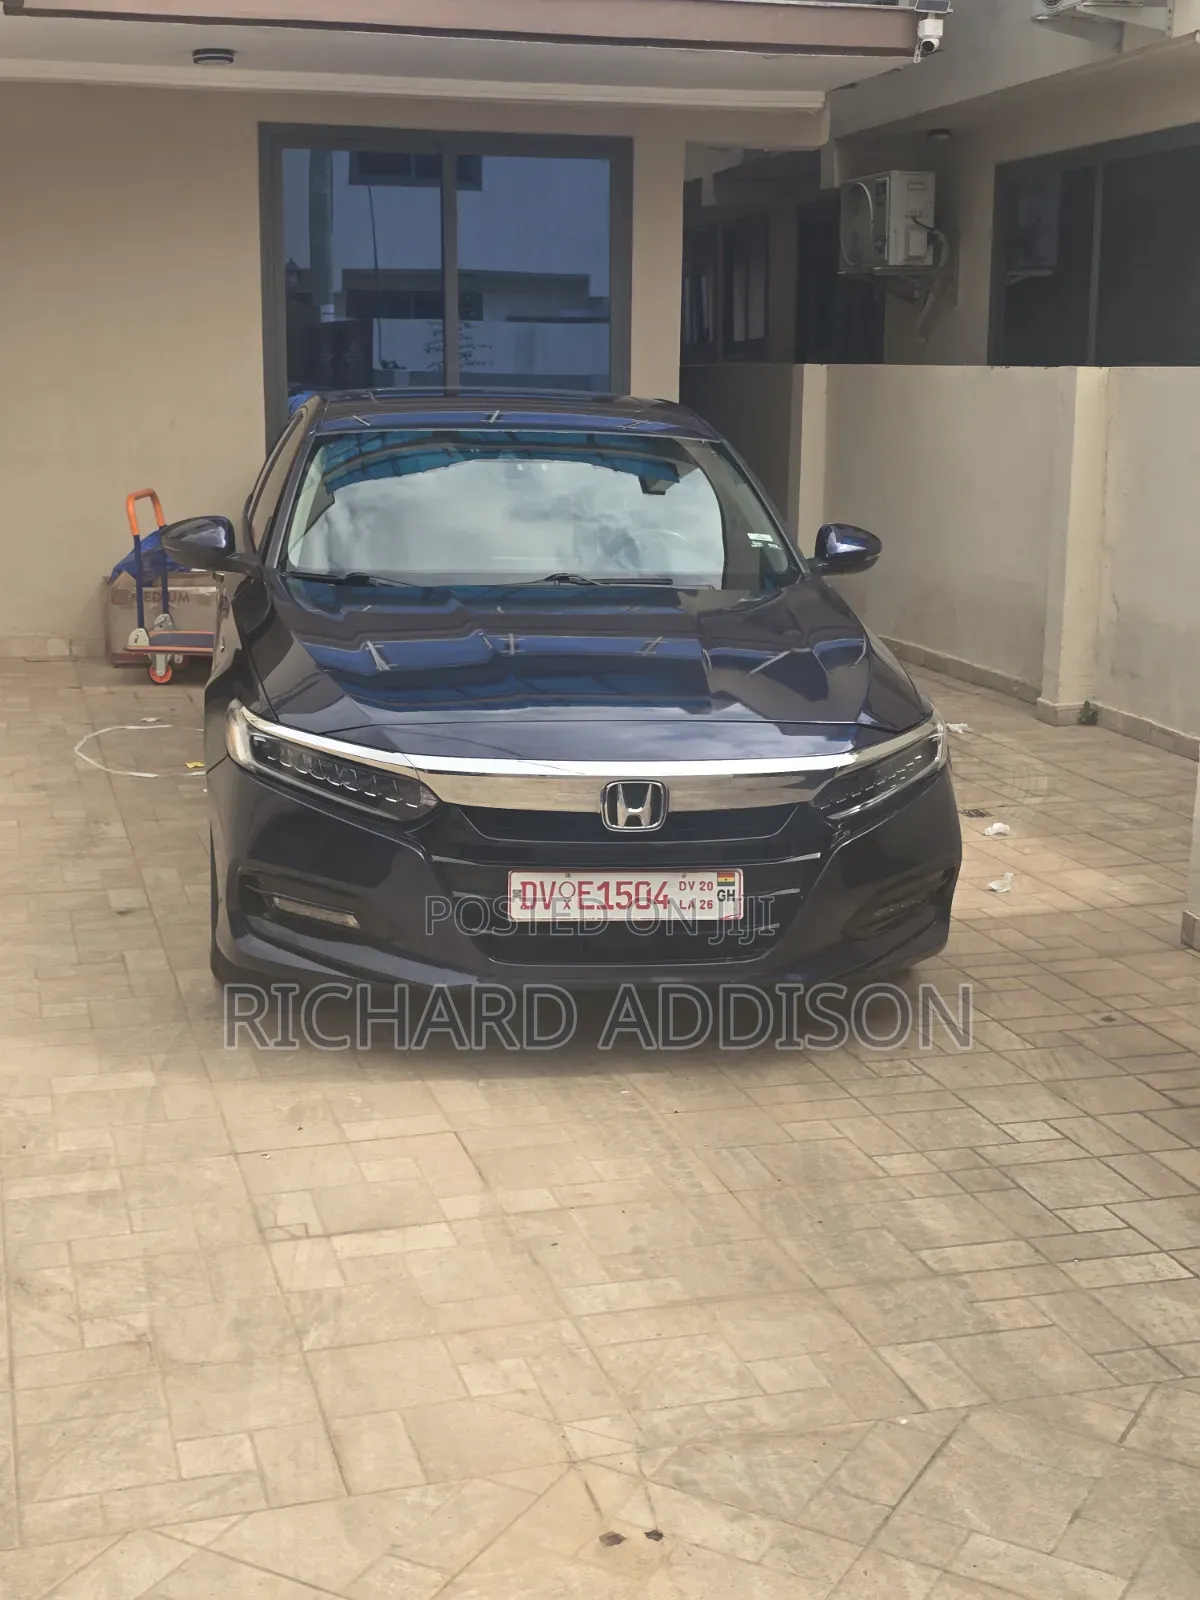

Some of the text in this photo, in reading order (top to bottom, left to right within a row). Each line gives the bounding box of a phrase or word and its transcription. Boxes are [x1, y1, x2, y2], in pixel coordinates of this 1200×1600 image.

[131, 591, 190, 604] EDUM
[678, 880, 714, 892] DV 20
[520, 880, 671, 910] DV E1504
[717, 889, 735, 902] GH
[678, 899, 714, 910] LA 26
